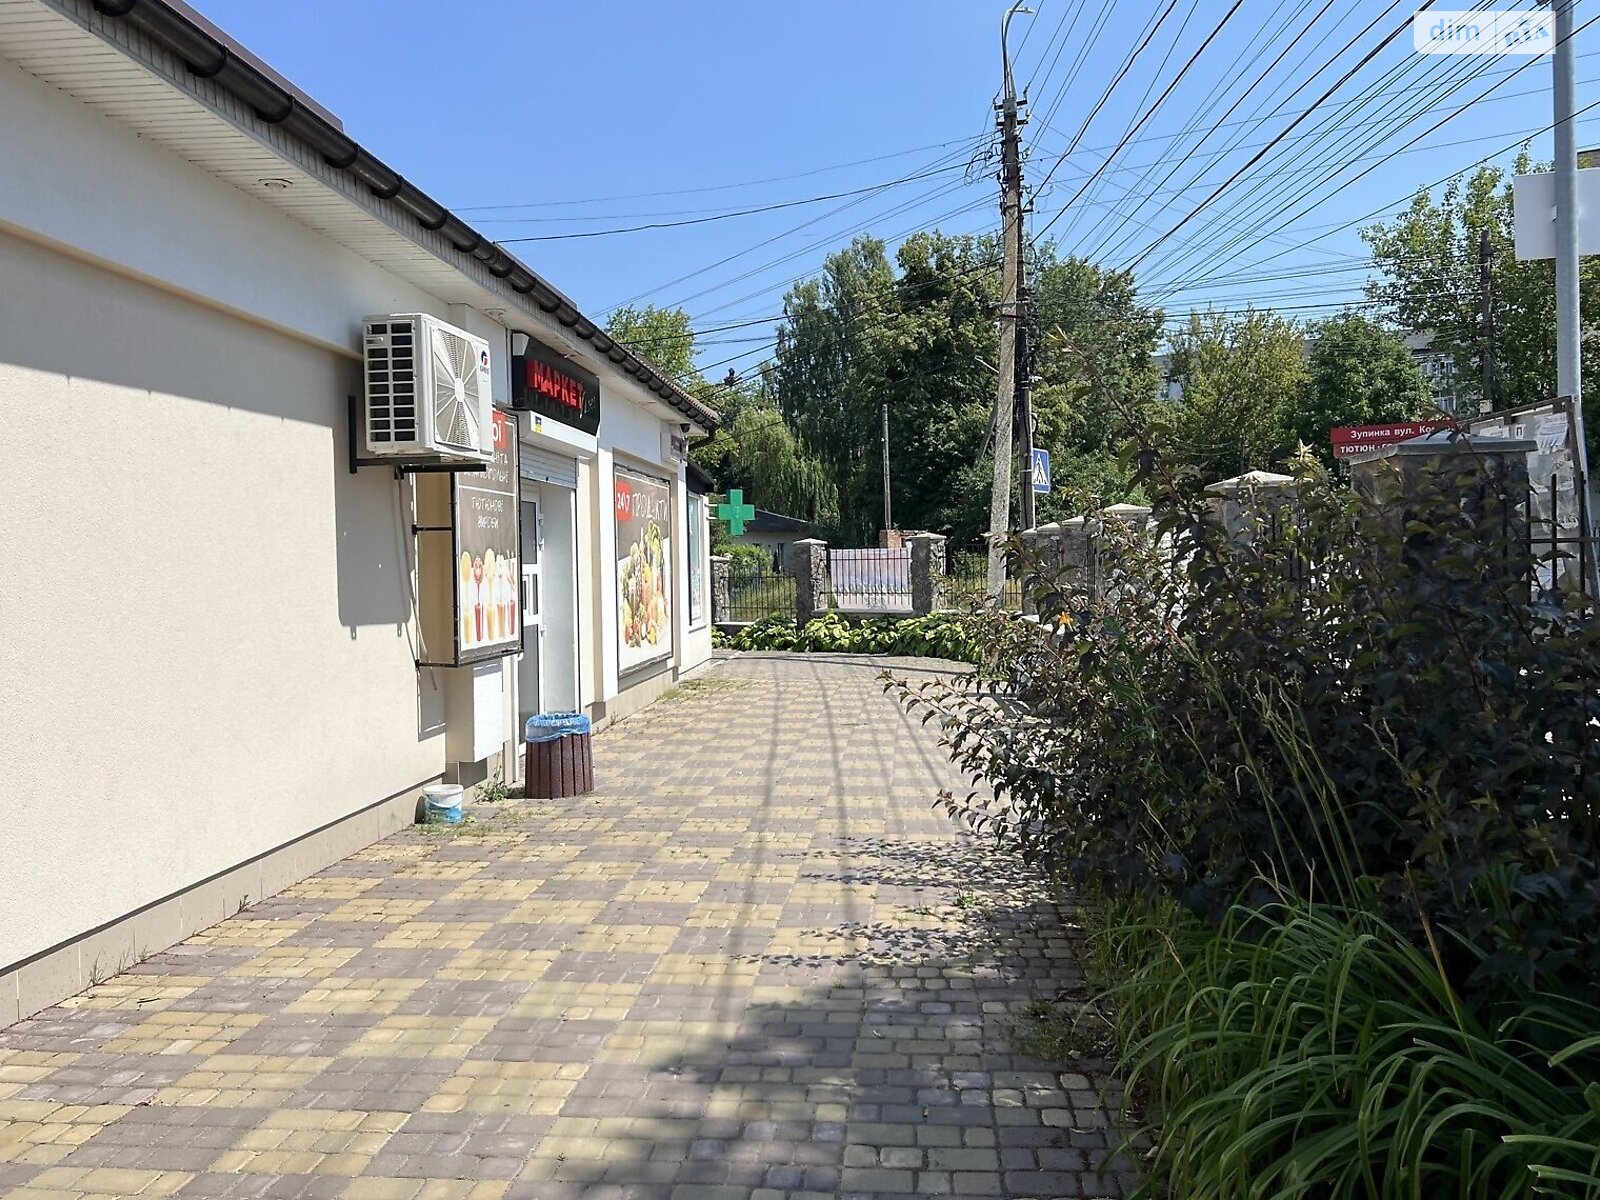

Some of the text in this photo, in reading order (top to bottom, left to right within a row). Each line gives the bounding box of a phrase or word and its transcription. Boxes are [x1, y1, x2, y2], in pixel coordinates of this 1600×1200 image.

[1350, 424, 1435, 440] Зупинка вул. Ко
